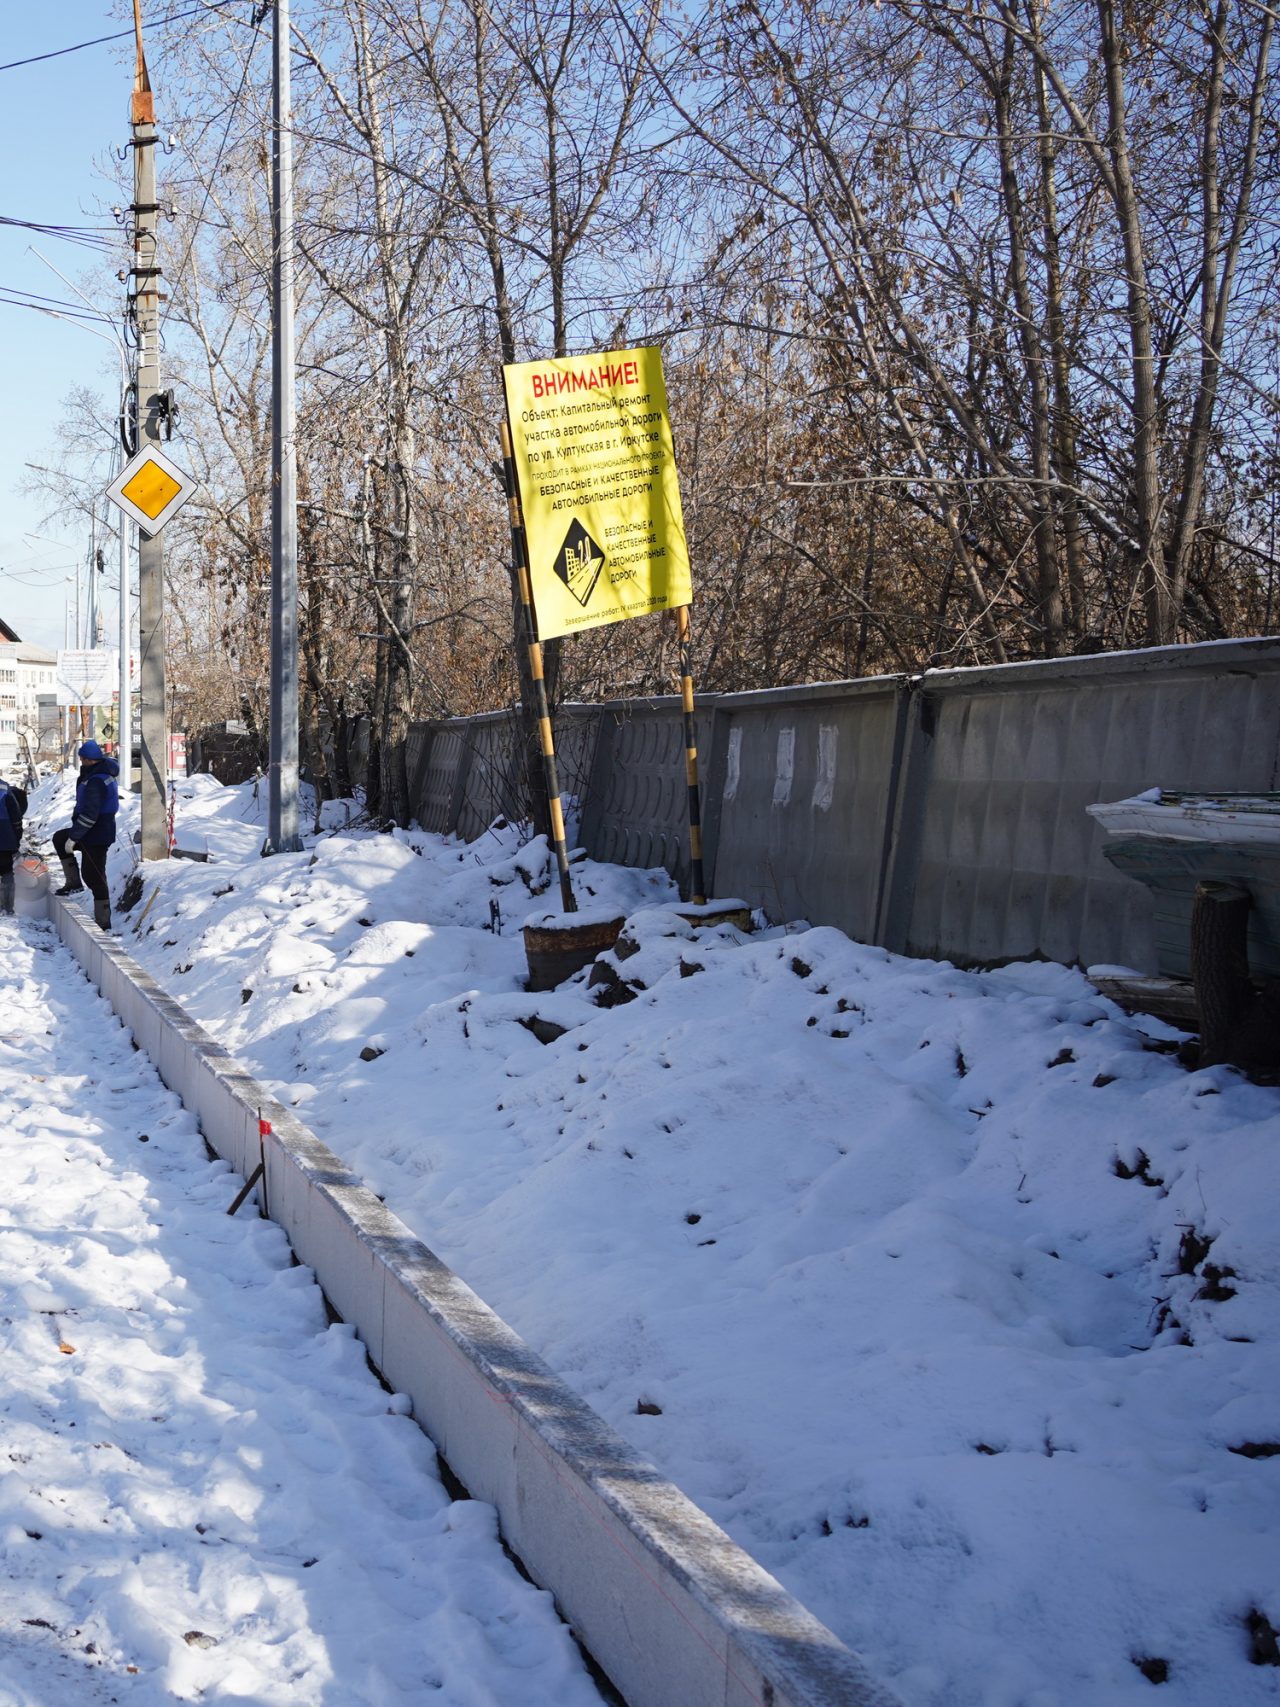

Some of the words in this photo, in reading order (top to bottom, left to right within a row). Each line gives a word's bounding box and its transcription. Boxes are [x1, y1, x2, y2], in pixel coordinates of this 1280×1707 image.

[532, 361, 639, 398] ВНИМАНИЕ!
[522, 407, 559, 423] Объект:
[560, 396, 618, 416] Капитальный
[619, 393, 651, 410] ремонт
[524, 428, 561, 446] участка
[563, 416, 629, 437] автомобильной
[632, 411, 662, 427] дороги
[528, 452, 540, 464] по
[541, 449, 555, 463] ул.
[556, 442, 605, 461] Култукская
[620, 431, 659, 449] Иркутске
[532, 469, 564, 481] ПРОХОДИТ
[570, 464, 592, 474] РАМКАХ
[593, 455, 641, 470] НАЦИОНАЛЬНОГО
[641, 450, 666, 462] ПРОЕКТА
[540, 476, 592, 497] БЕЗОПАСНЫЕ
[593, 477, 599, 485] И
[600, 465, 660, 485] КАЧЕСТВЕННЫЕ
[552, 488, 621, 511] АВТОМОБИЛЬНЫЕ
[622, 483, 653, 499] ДОРОГИ
[604, 522, 647, 538] БЕЗОПАСНЫЕ
[648, 520, 654, 529] И
[606, 533, 657, 552] КАЧЕСТВЕННЫЕ
[608, 547, 666, 568] АВТОМОБИЛЬНЫЕ
[610, 570, 638, 585] ДОРОГИ
